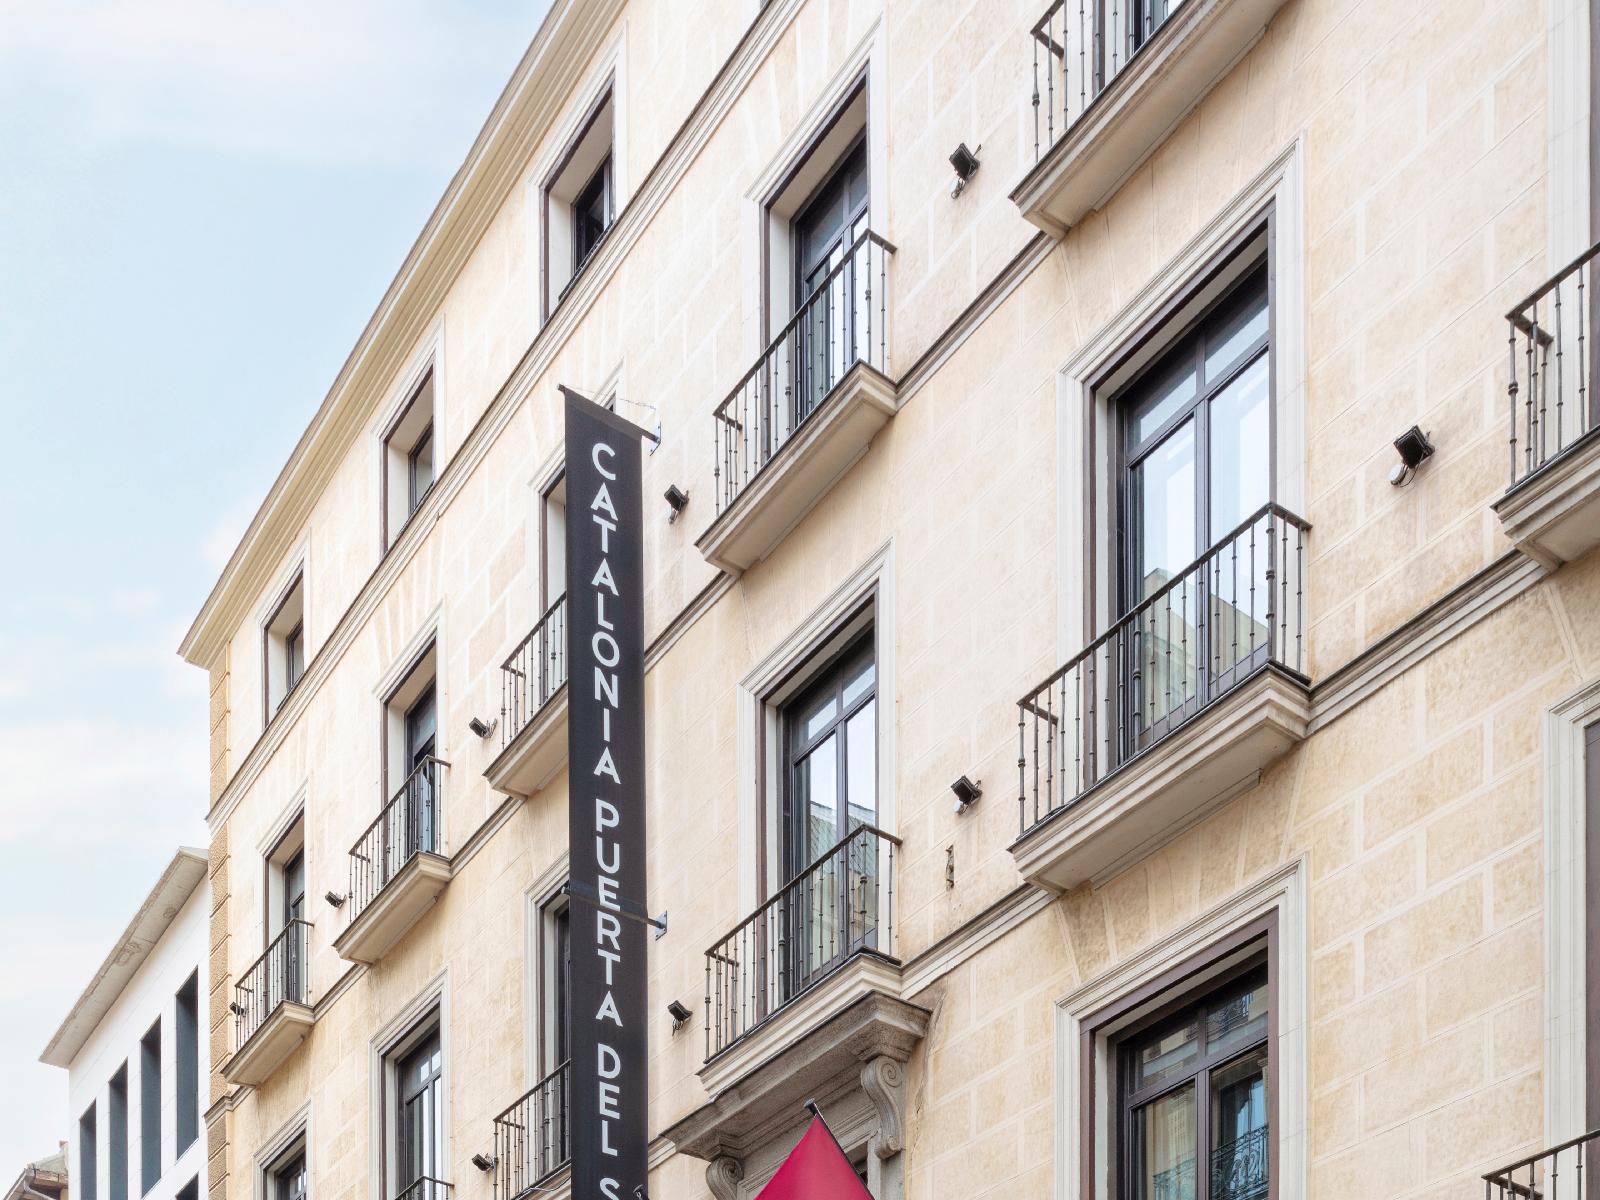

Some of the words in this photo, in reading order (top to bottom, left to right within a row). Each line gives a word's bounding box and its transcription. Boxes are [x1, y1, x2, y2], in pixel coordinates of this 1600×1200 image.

[590, 442, 621, 785] CATALONIA
[596, 798, 624, 1028] PUERTA
[597, 1042, 621, 1157] DEL
